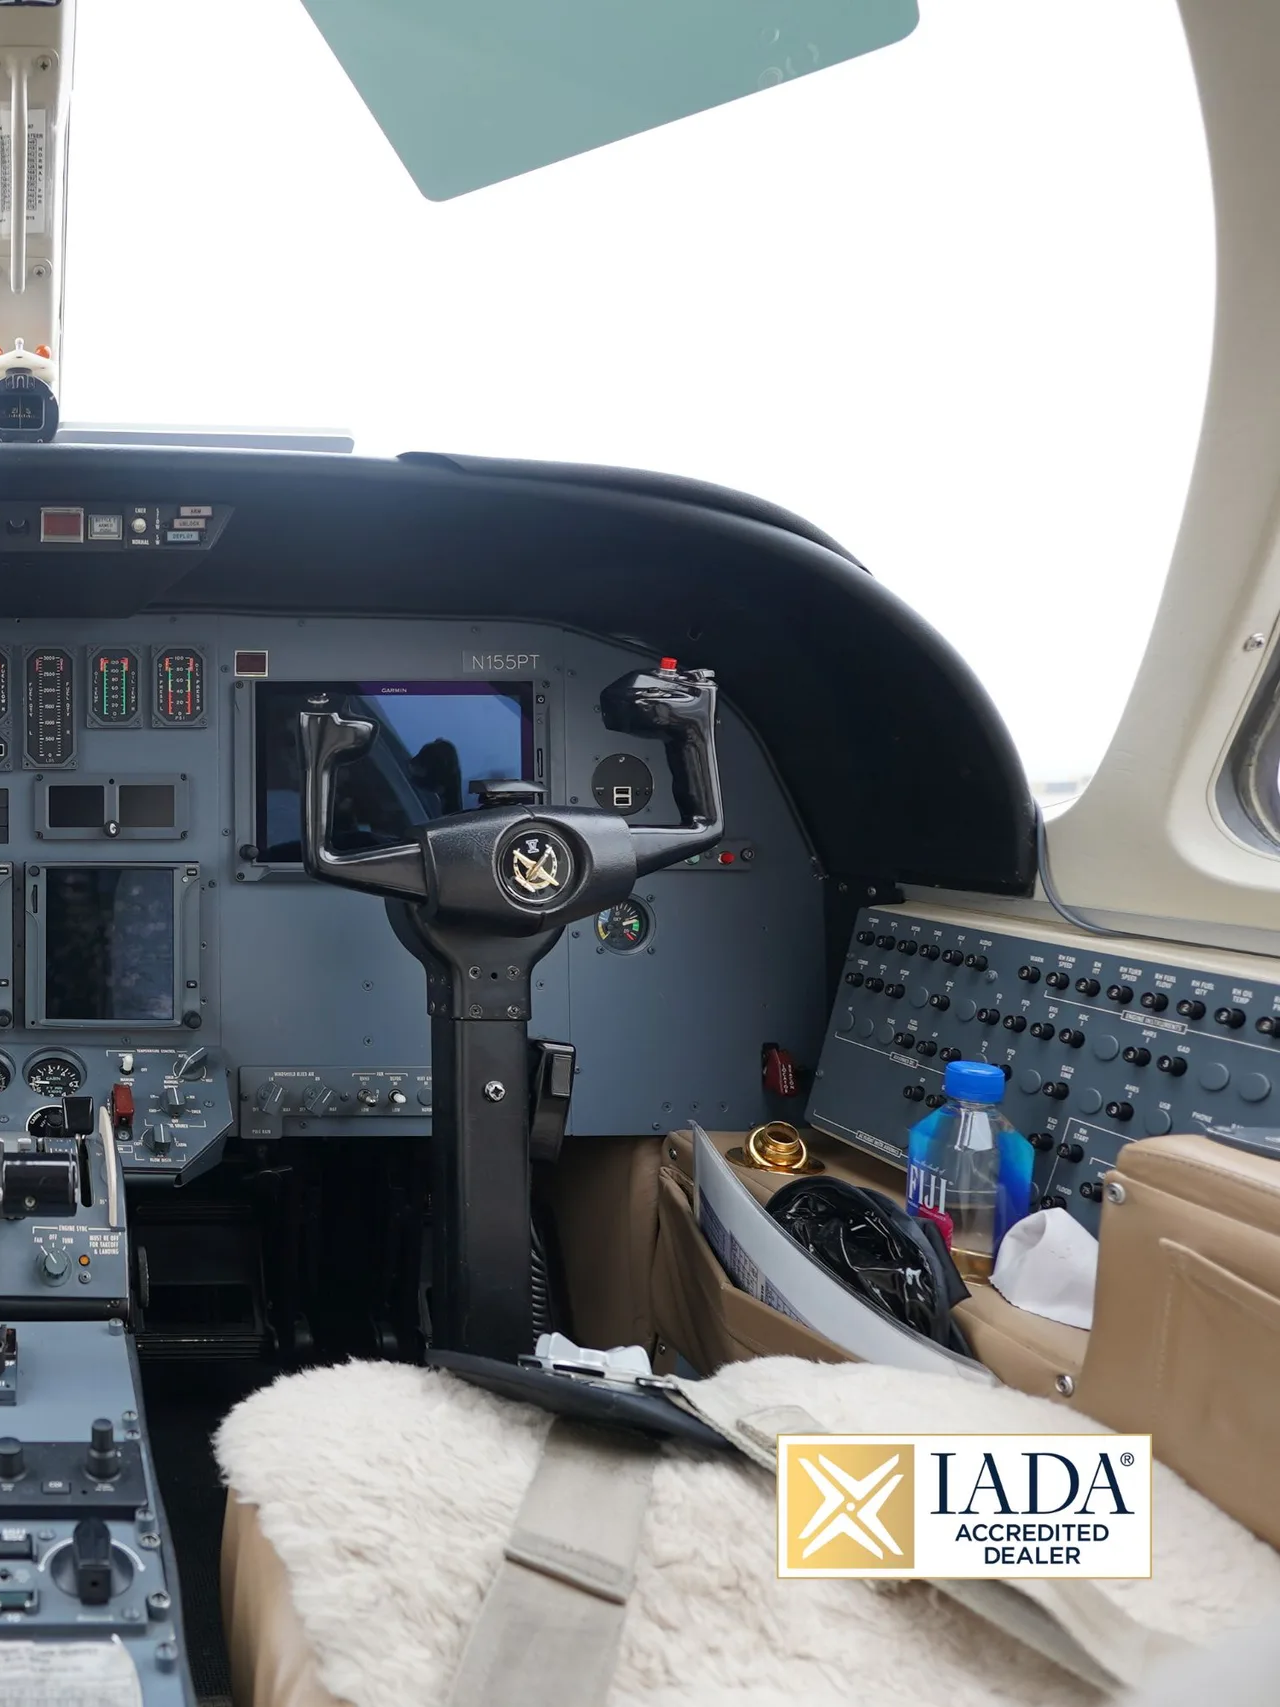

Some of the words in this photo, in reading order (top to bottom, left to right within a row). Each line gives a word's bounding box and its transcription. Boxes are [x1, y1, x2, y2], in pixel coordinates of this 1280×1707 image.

[472, 654, 540, 670] N155PT
[1194, 988, 1208, 996] QTY
[1232, 996, 1250, 1004] TEMP
[1125, 1014, 1144, 1022] ENGINE
[1144, 1018, 1182, 1032] INSTRUMENTS
[1176, 1044, 1190, 1054] GAD
[30, 1112, 41, 1124] CABIN
[1192, 1111, 1213, 1124] PHONE
[1073, 1132, 1090, 1144] START
[908, 1164, 948, 1215] FIJI
